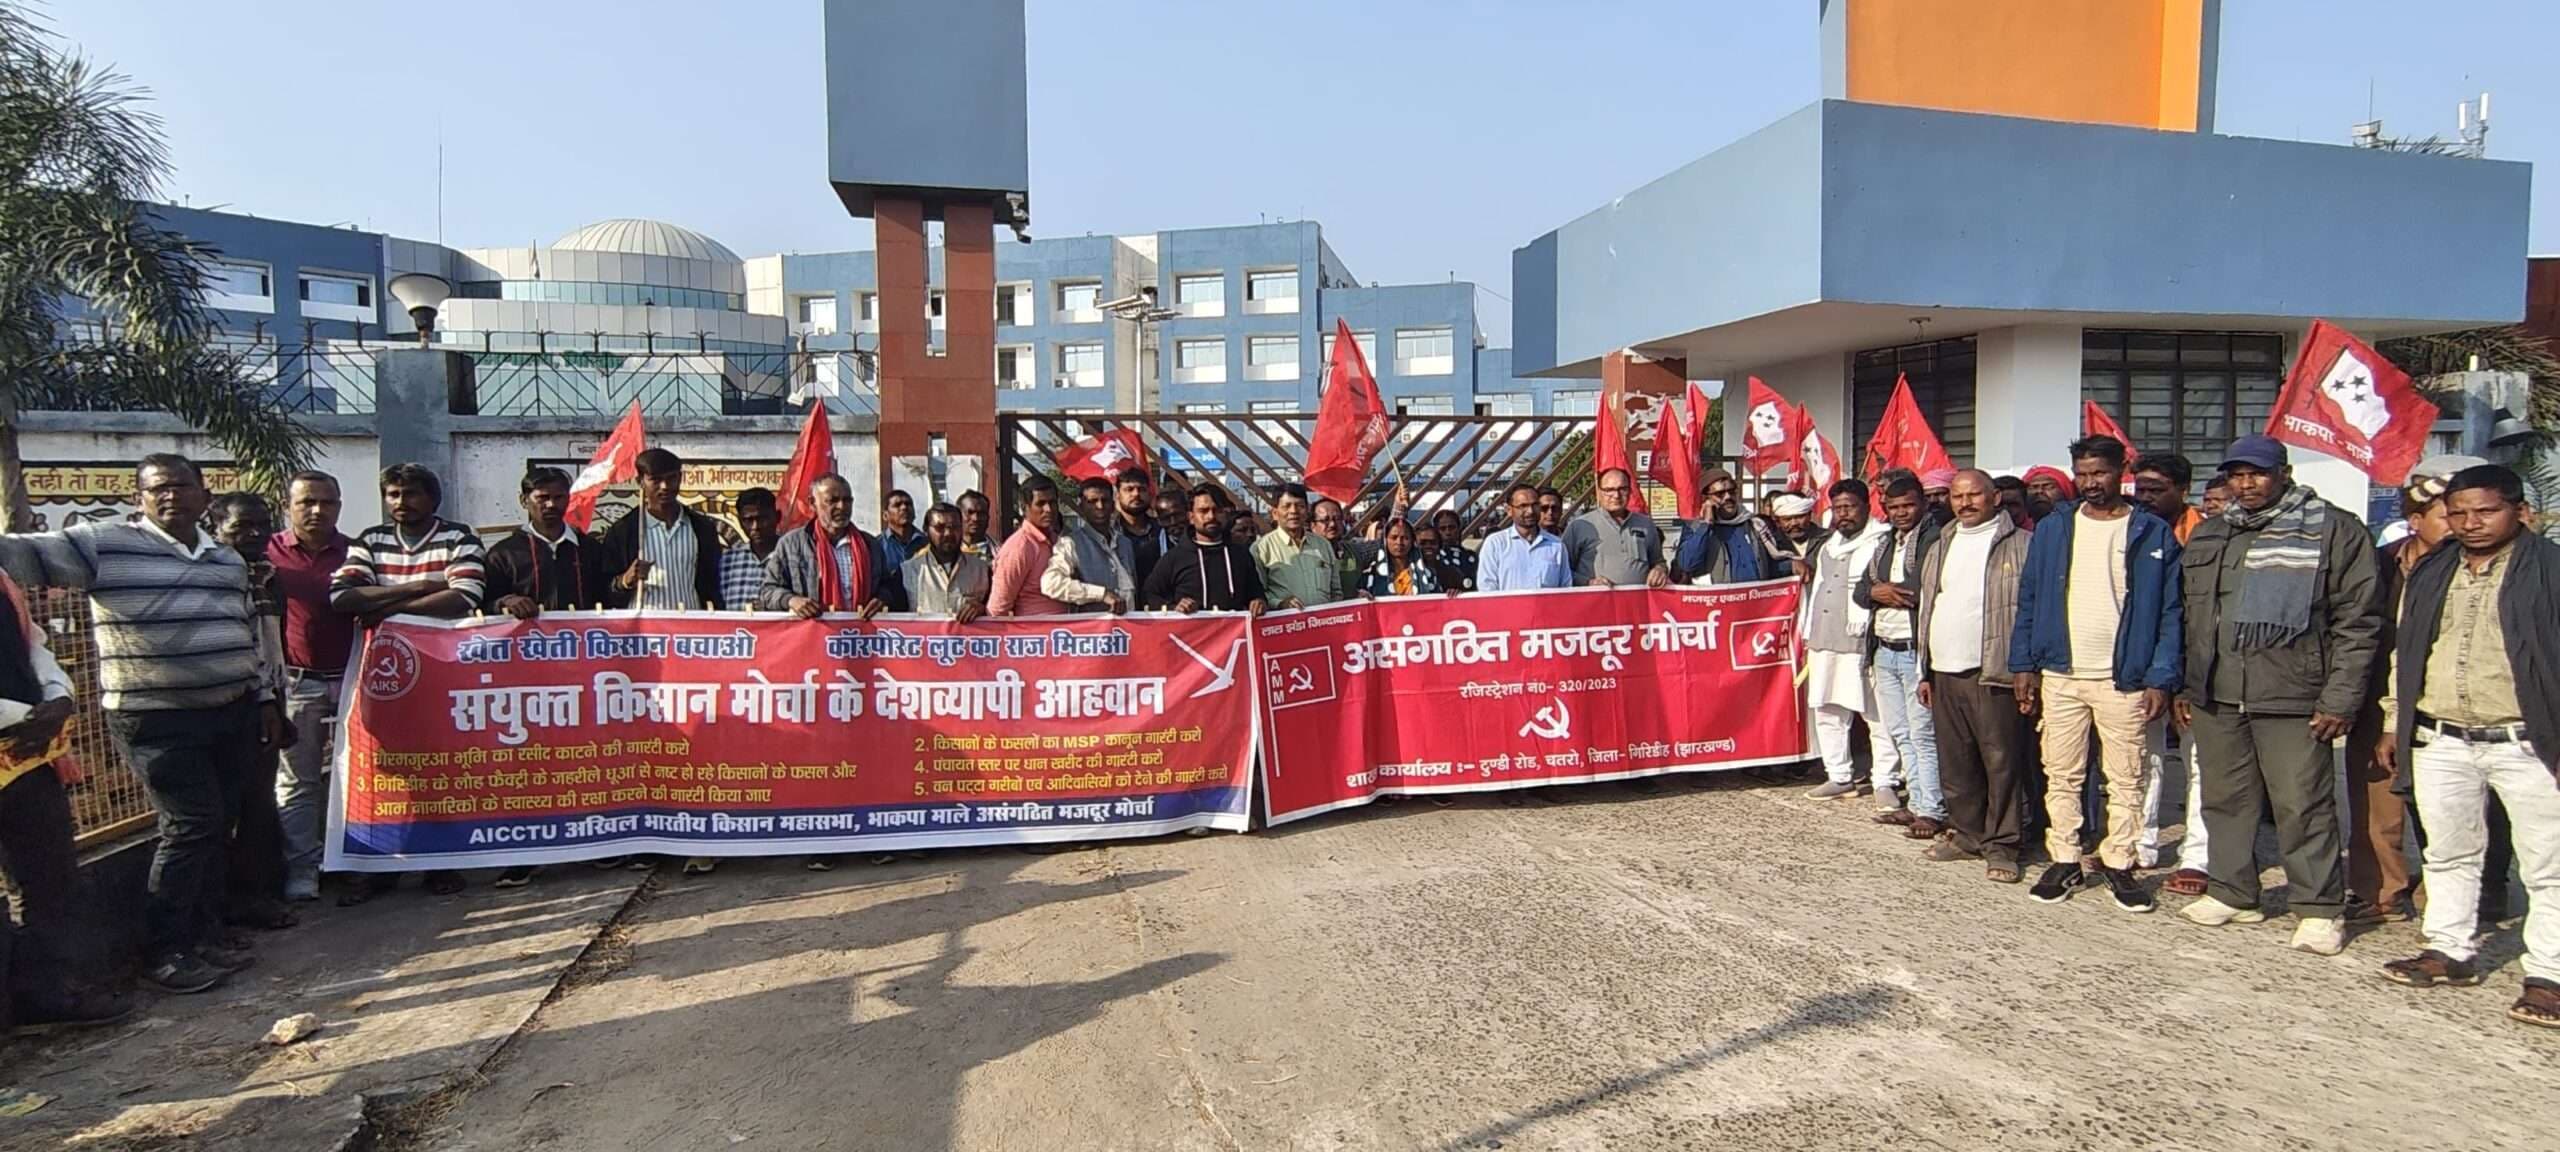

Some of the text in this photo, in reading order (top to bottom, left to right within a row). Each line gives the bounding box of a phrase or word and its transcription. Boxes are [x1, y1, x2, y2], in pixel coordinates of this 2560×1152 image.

[2283, 414, 2337, 445] भाकपा
[457, 627, 757, 663] खेत खेती किसान बचाओ
[826, 626, 1131, 667] कॉरपोरेट लूट का राज मिटाओ
[1342, 610, 1722, 675] असंगठित मजदूर मोर्चा
[370, 680, 400, 693] AIKS
[1558, 677, 1617, 694] 320/2023
[449, 668, 1167, 745] संयुक्त किसान मोर्चा के देशव्यापी आहवान
[454, 746, 487, 769] भूमि
[492, 748, 513, 765] का
[518, 744, 551, 763] रसीद
[555, 741, 598, 761] काटने
[602, 739, 622, 757] की
[626, 738, 662, 756] गारंटी
[665, 738, 690, 757] करो
[914, 726, 1202, 752] 2. किसानों के फसलों का MSP कानून गारंटी करो
[432, 772, 449, 791] के
[454, 771, 484, 791] लौह
[532, 769, 549, 787] के
[552, 764, 600, 786] जहरीले
[639, 761, 652, 780] से
[654, 764, 679, 782] नष्ट
[681, 762, 694, 783] हो
[697, 763, 715, 782] रहे
[717, 762, 770, 782] किसानों
[772, 762, 787, 780] के
[790, 764, 828, 780] फसल
[832, 760, 857, 780] और
[914, 748, 1163, 774] 4. पंचायत स्तर पर धान खरीद की गारंटी करो
[1378, 758, 1452, 778] कार्यालय
[1628, 742, 1671, 761] गिरिडीह
[914, 781, 929, 796] 5.
[933, 779, 953, 794] वन
[1025, 774, 1044, 792] एवं
[1114, 769, 1132, 788] को
[1134, 769, 1153, 787] देने
[1155, 767, 1172, 786] की
[1207, 763, 1229, 781] करो
[374, 800, 407, 817] आम
[482, 794, 499, 812] के
[555, 791, 577, 809] की
[580, 790, 607, 806] रक्षा
[612, 783, 648, 803] करने
[651, 784, 668, 802] की
[670, 786, 705, 804] गारंटी
[708, 786, 743, 803] किया
[745, 788, 772, 803] जाए
[469, 795, 1156, 845] AICCTU अखिल भारतीय किसान महासभा, भाकपा माले असंगठित मजदूर मोर्चा
